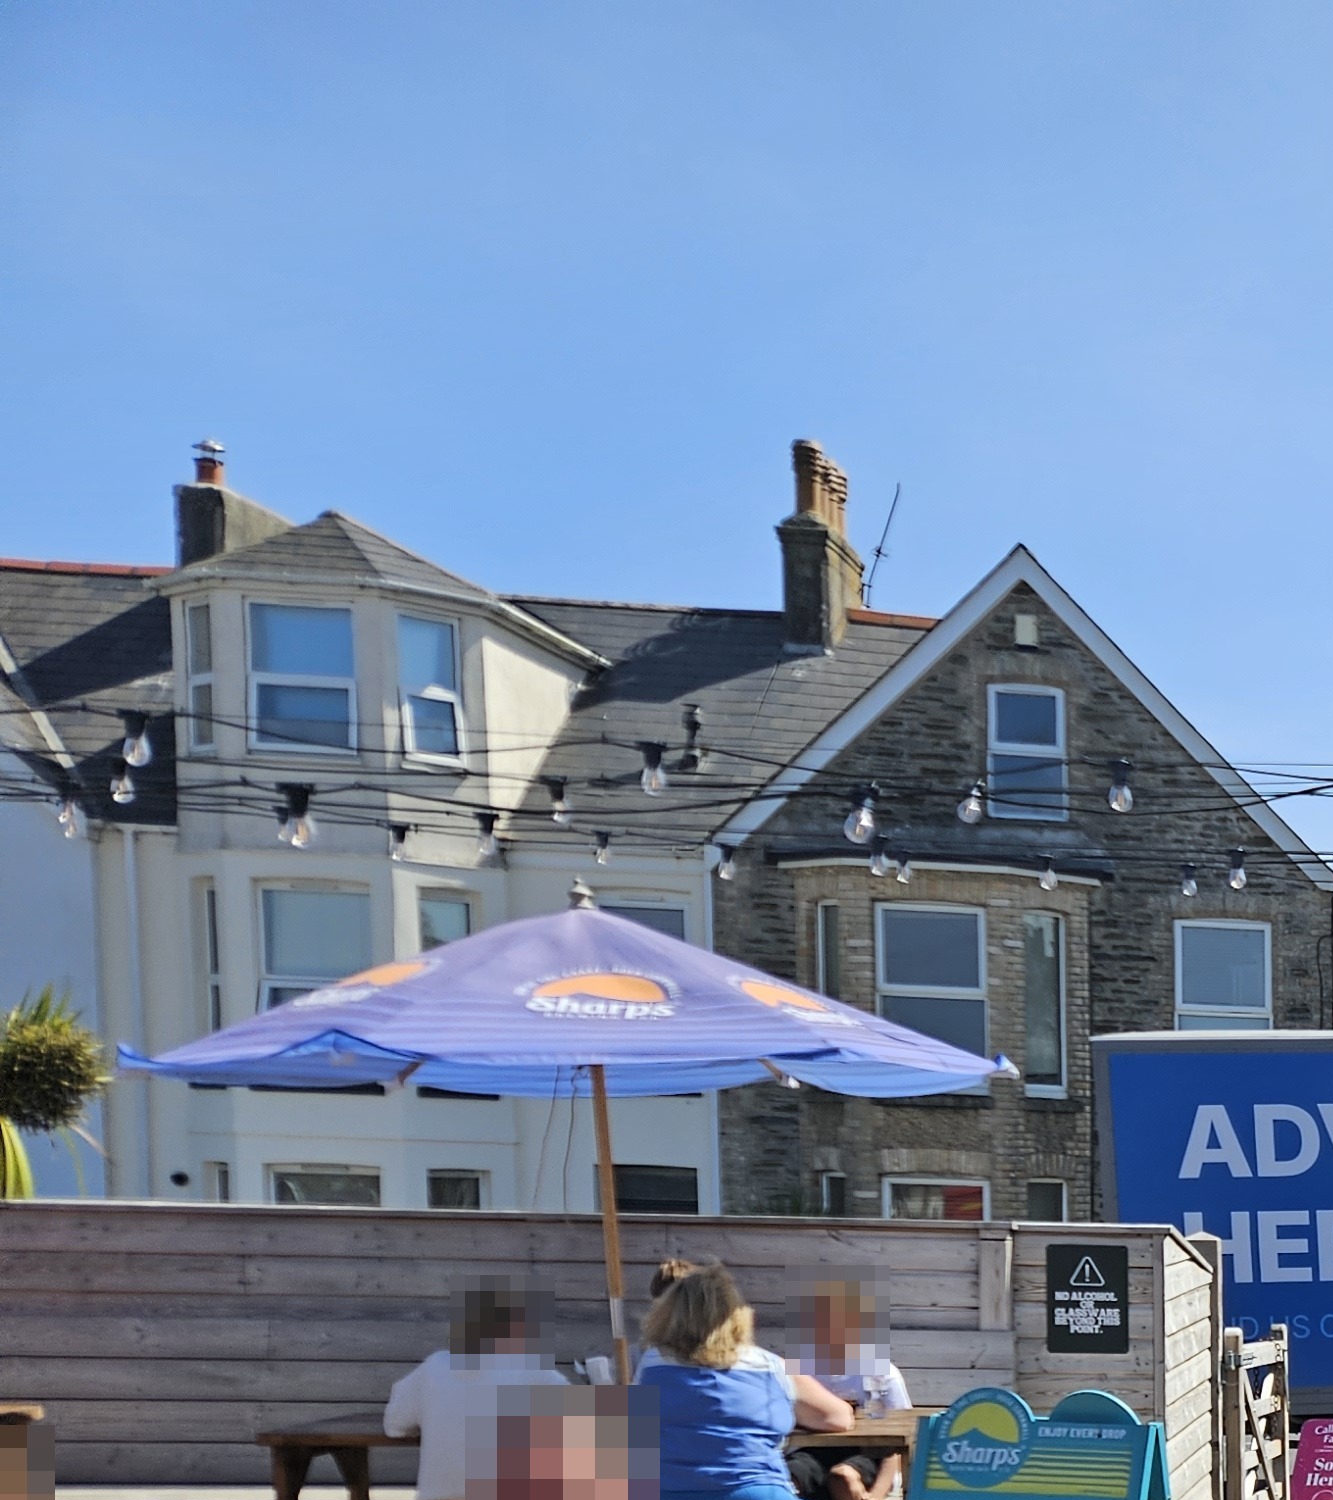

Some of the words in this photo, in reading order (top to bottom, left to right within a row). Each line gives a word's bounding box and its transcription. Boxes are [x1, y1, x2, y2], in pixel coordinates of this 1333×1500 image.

[1055, 1291, 1069, 1301] NO
[1070, 1291, 1118, 1302] ALCOHOL
[1079, 1301, 1095, 1309] OR
[1054, 1308, 1121, 1318] GLASSWARE
[1055, 1317, 1096, 1326] BEYOND
[1097, 1317, 1121, 1326] THIS
[1037, 1426, 1069, 1438] ENJOY
[1101, 1428, 1127, 1439] DROP
